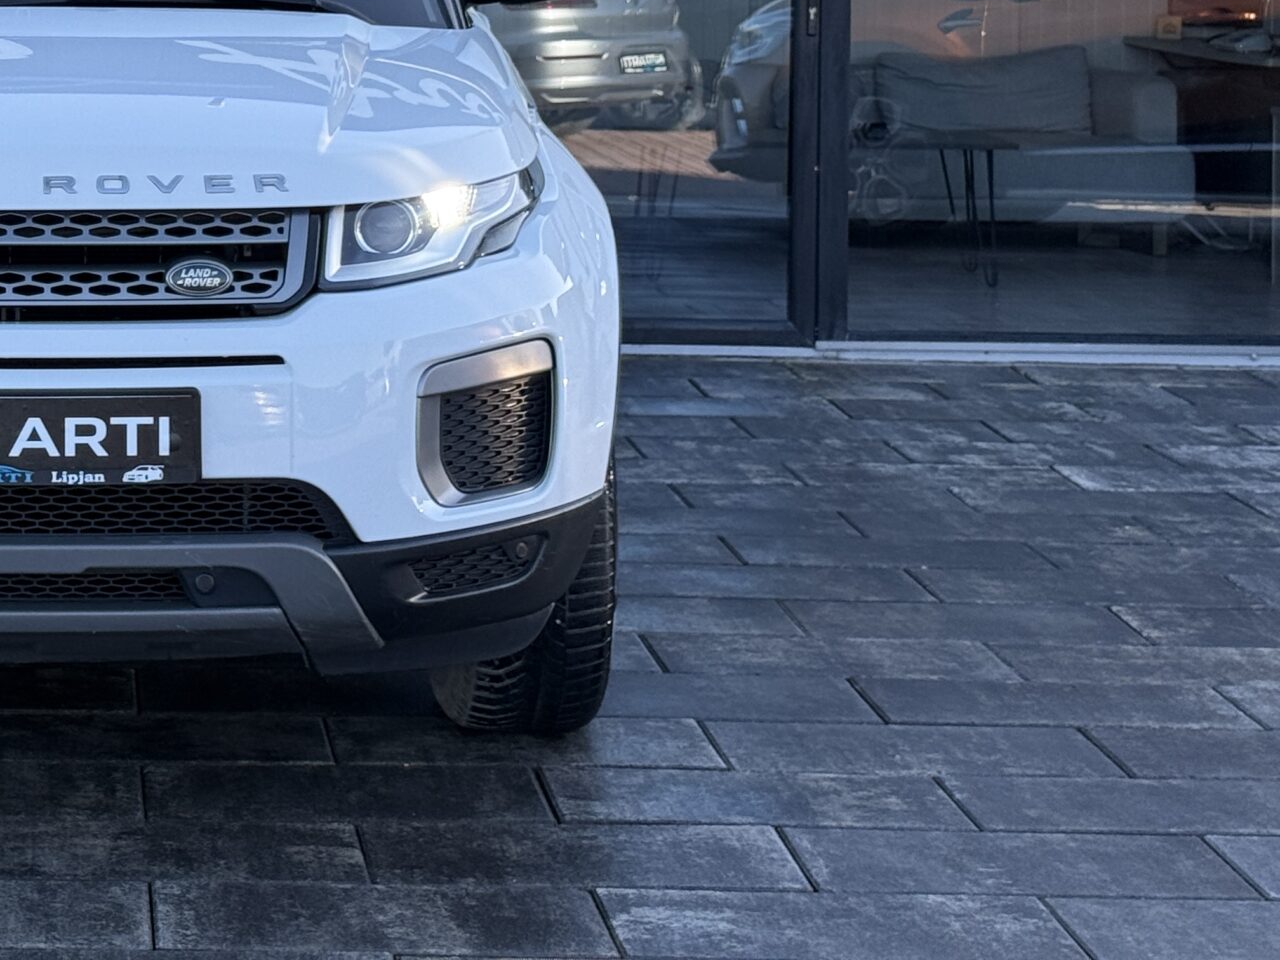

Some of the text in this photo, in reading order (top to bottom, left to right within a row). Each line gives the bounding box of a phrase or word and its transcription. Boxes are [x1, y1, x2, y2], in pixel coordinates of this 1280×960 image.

[43, 174, 290, 195] ROVER
[180, 268, 211, 278] LAND
[183, 278, 221, 287] ROVER
[8, 416, 170, 457] ARTI
[51, 470, 106, 485] Lipjan
